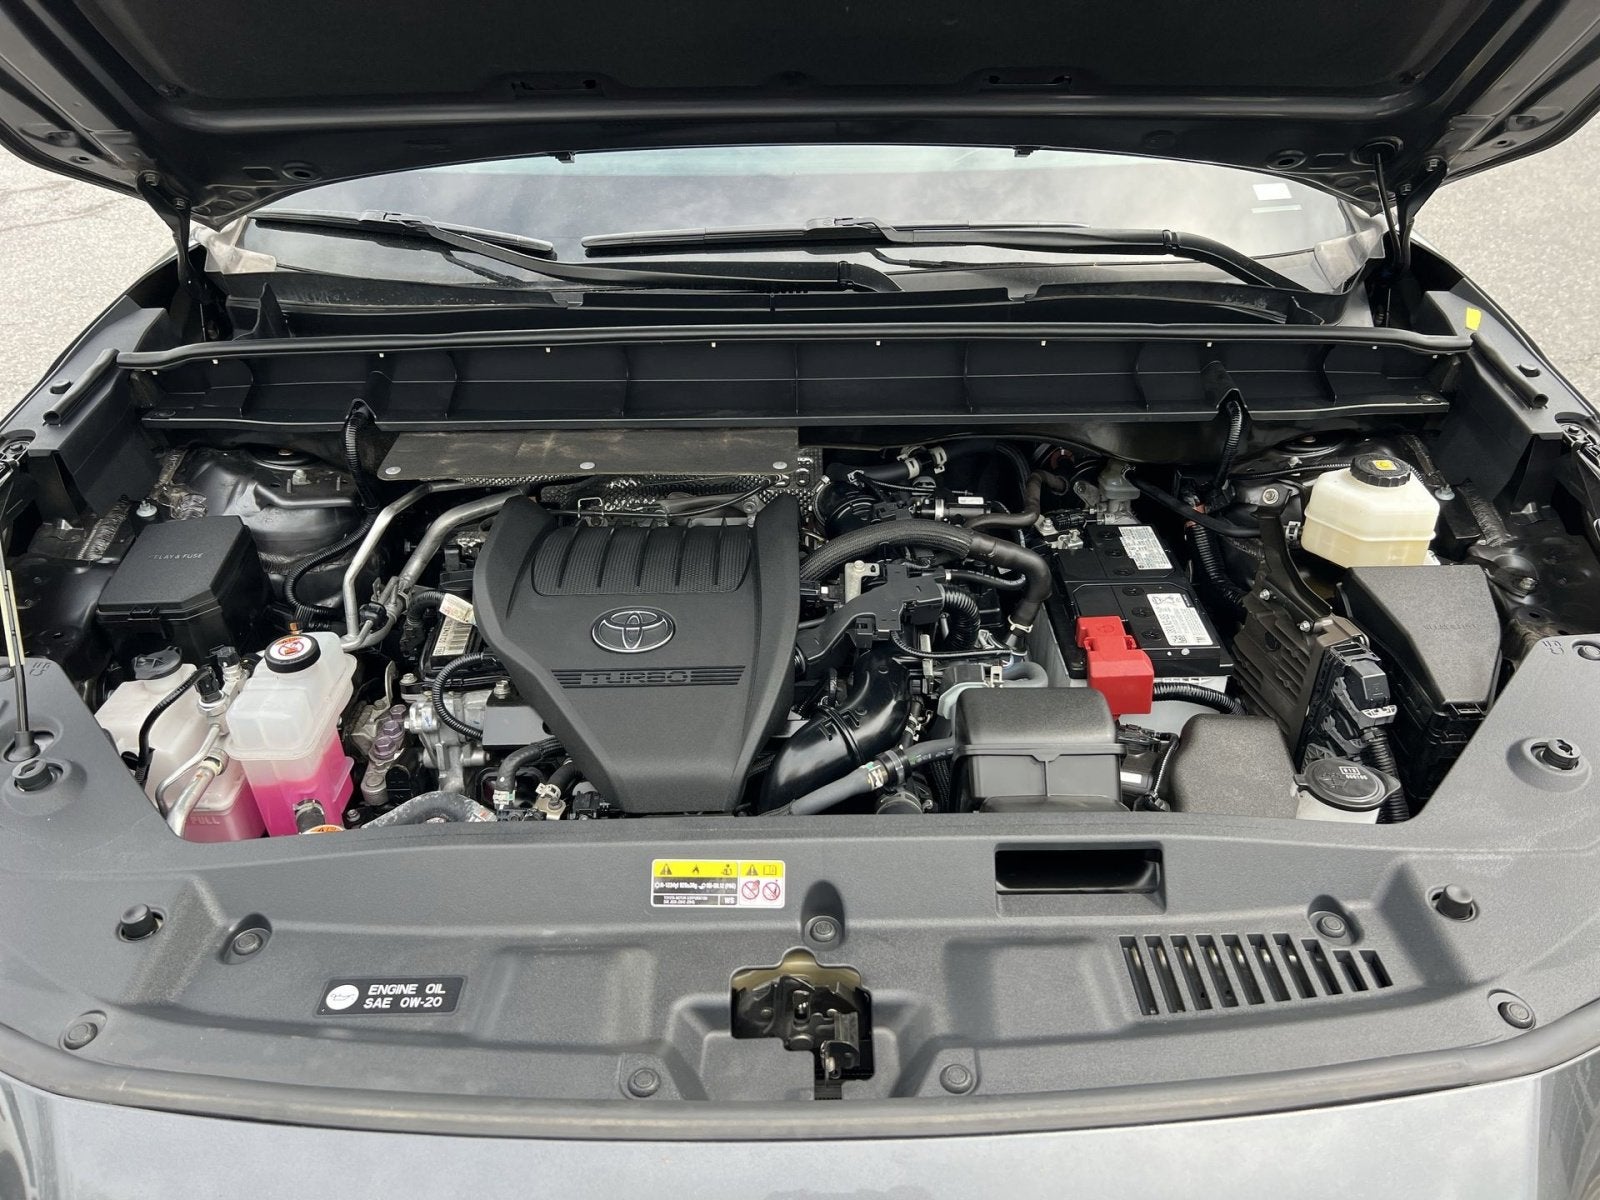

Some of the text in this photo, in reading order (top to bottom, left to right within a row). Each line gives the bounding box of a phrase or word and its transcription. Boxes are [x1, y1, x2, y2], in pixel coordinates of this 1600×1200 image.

[584, 671, 688, 684] TURBO
[190, 816, 220, 825] FULL
[367, 983, 446, 995] ENGINE OIL
[363, 996, 443, 1009] SAE 0W-20
